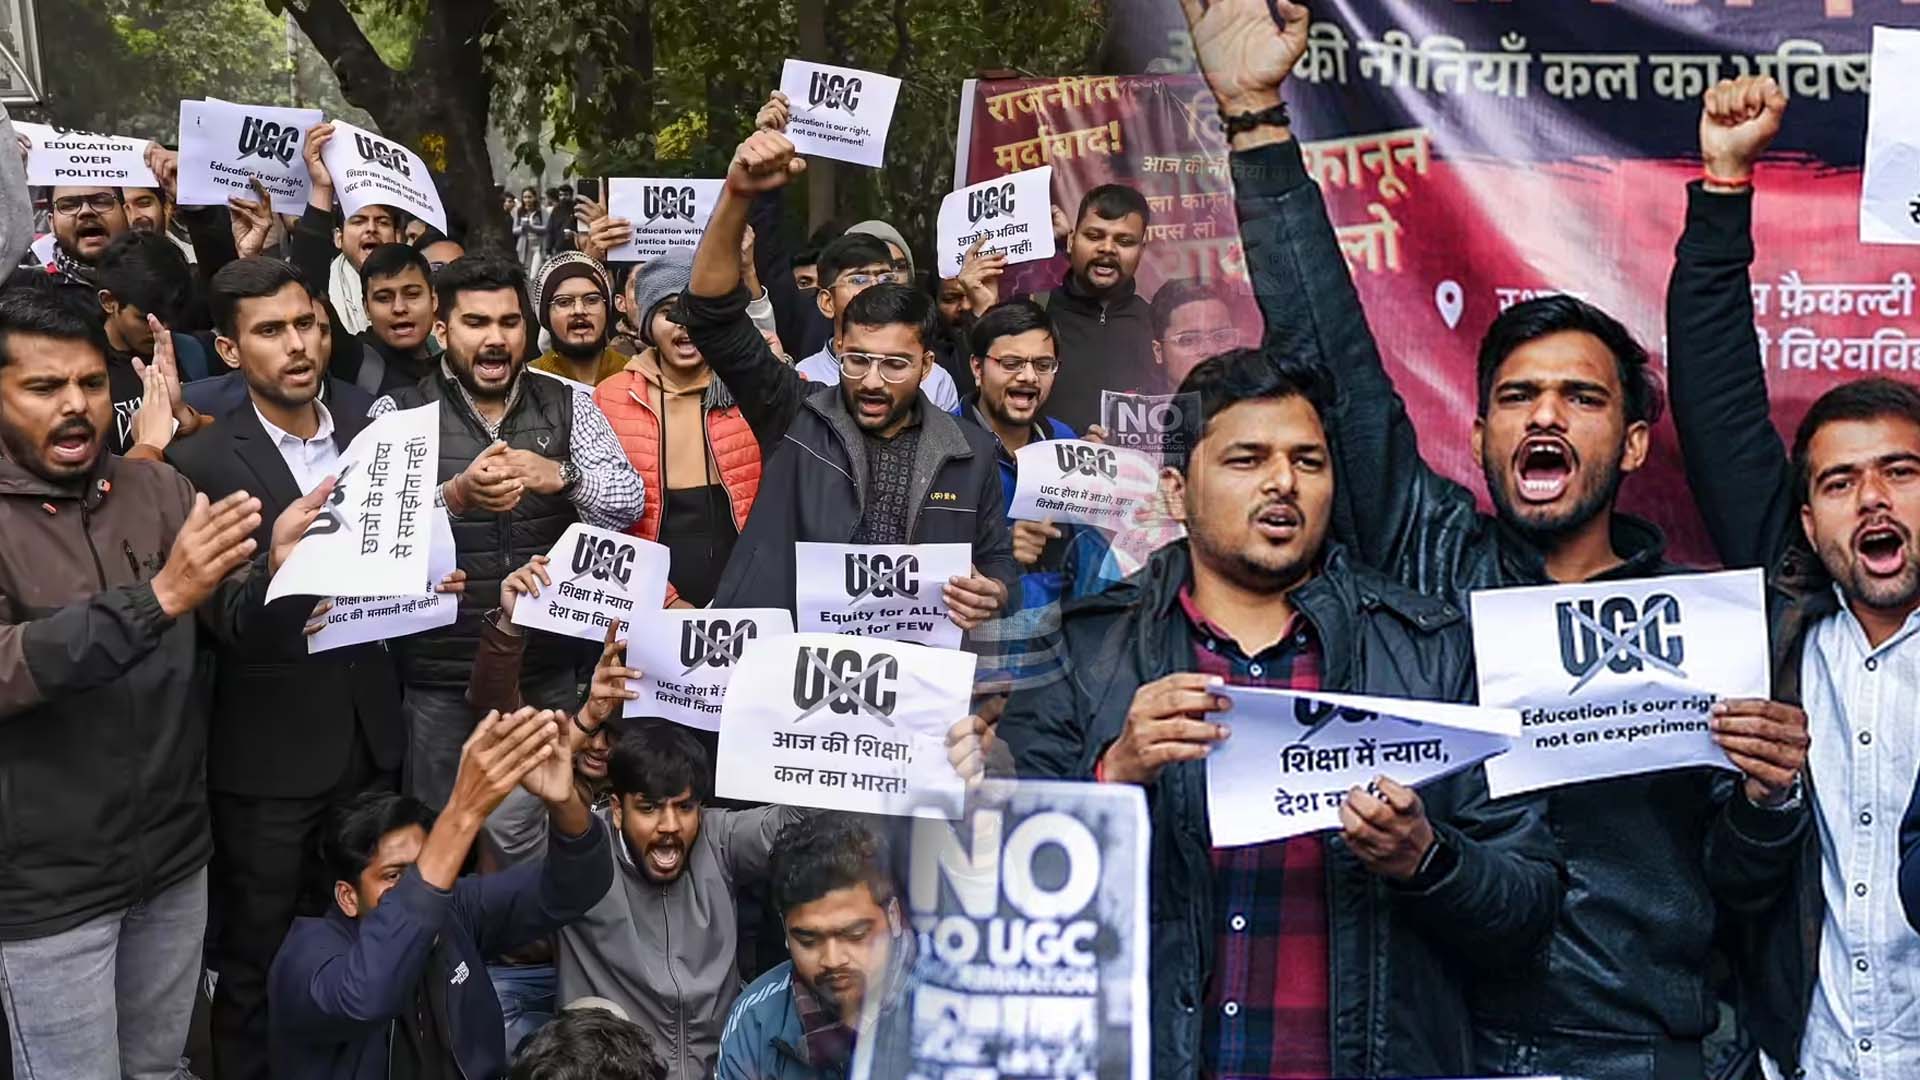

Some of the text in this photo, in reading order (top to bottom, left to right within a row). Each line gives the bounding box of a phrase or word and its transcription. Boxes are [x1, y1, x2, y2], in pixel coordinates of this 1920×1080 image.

[1357, 30, 1531, 98] नीतियाँ
[1541, 53, 1640, 100] कल
[1649, 54, 1722, 99] का
[809, 71, 862, 111] UGC
[238, 116, 299, 162] UGC
[792, 127, 805, 135] not
[818, 132, 864, 147] experiment!
[826, 121, 832, 129] is
[834, 124, 847, 132] our
[44, 141, 133, 151] EDUCATION
[70, 155, 111, 164] OVER
[354, 133, 410, 177] UGC
[55, 168, 128, 178] POLITICS!
[1142, 156, 1181, 173] आज
[213, 176, 229, 185] not
[232, 180, 243, 188] an
[257, 171, 263, 179] is
[265, 174, 280, 182] our
[281, 174, 304, 188] right,
[643, 186, 695, 219] UGC
[968, 183, 1015, 222] UGC
[669, 238, 695, 246] builds
[1143, 214, 1216, 242] ापस लो
[1010, 239, 1032, 254] नहीं!
[1778, 270, 1915, 319] फ़ैकल्टी
[1118, 402, 1184, 432] NO
[1118, 433, 1184, 445] TO UGC
[1055, 444, 1118, 479] UGC
[1040, 485, 1060, 496] UGC
[1061, 486, 1079, 499] होश
[1080, 489, 1088, 500] में
[571, 532, 635, 585] UGC
[845, 554, 919, 598] UGC
[558, 581, 591, 602] शिक्षा
[593, 588, 604, 604] में
[328, 613, 348, 624] UGC
[350, 609, 363, 620] की
[367, 603, 401, 618] मनमानी
[402, 599, 416, 613] नहीं
[549, 600, 570, 619] देश
[572, 609, 590, 623] का
[820, 611, 874, 624] Equity
[880, 609, 904, 617] for
[868, 624, 890, 634] for
[896, 622, 934, 632] FEW
[1555, 593, 1684, 677] UGC
[680, 619, 757, 668] UGC
[684, 683, 708, 696] होश
[710, 684, 720, 696] में
[793, 647, 898, 717] UGC
[656, 691, 691, 708] विरोधी
[1521, 701, 1617, 726] Education
[1623, 700, 1638, 715] is
[1643, 700, 1678, 713] our
[1536, 717, 1709, 749] not an experimen
[772, 731, 913, 764] आज की शिक्षा,
[1281, 738, 1449, 773] शिक्षा में न्याय,
[774, 765, 907, 795] कल का भारत!
[1275, 788, 1319, 816] देश
[909, 807, 1102, 919] NO
[989, 918, 1099, 968] UGC
